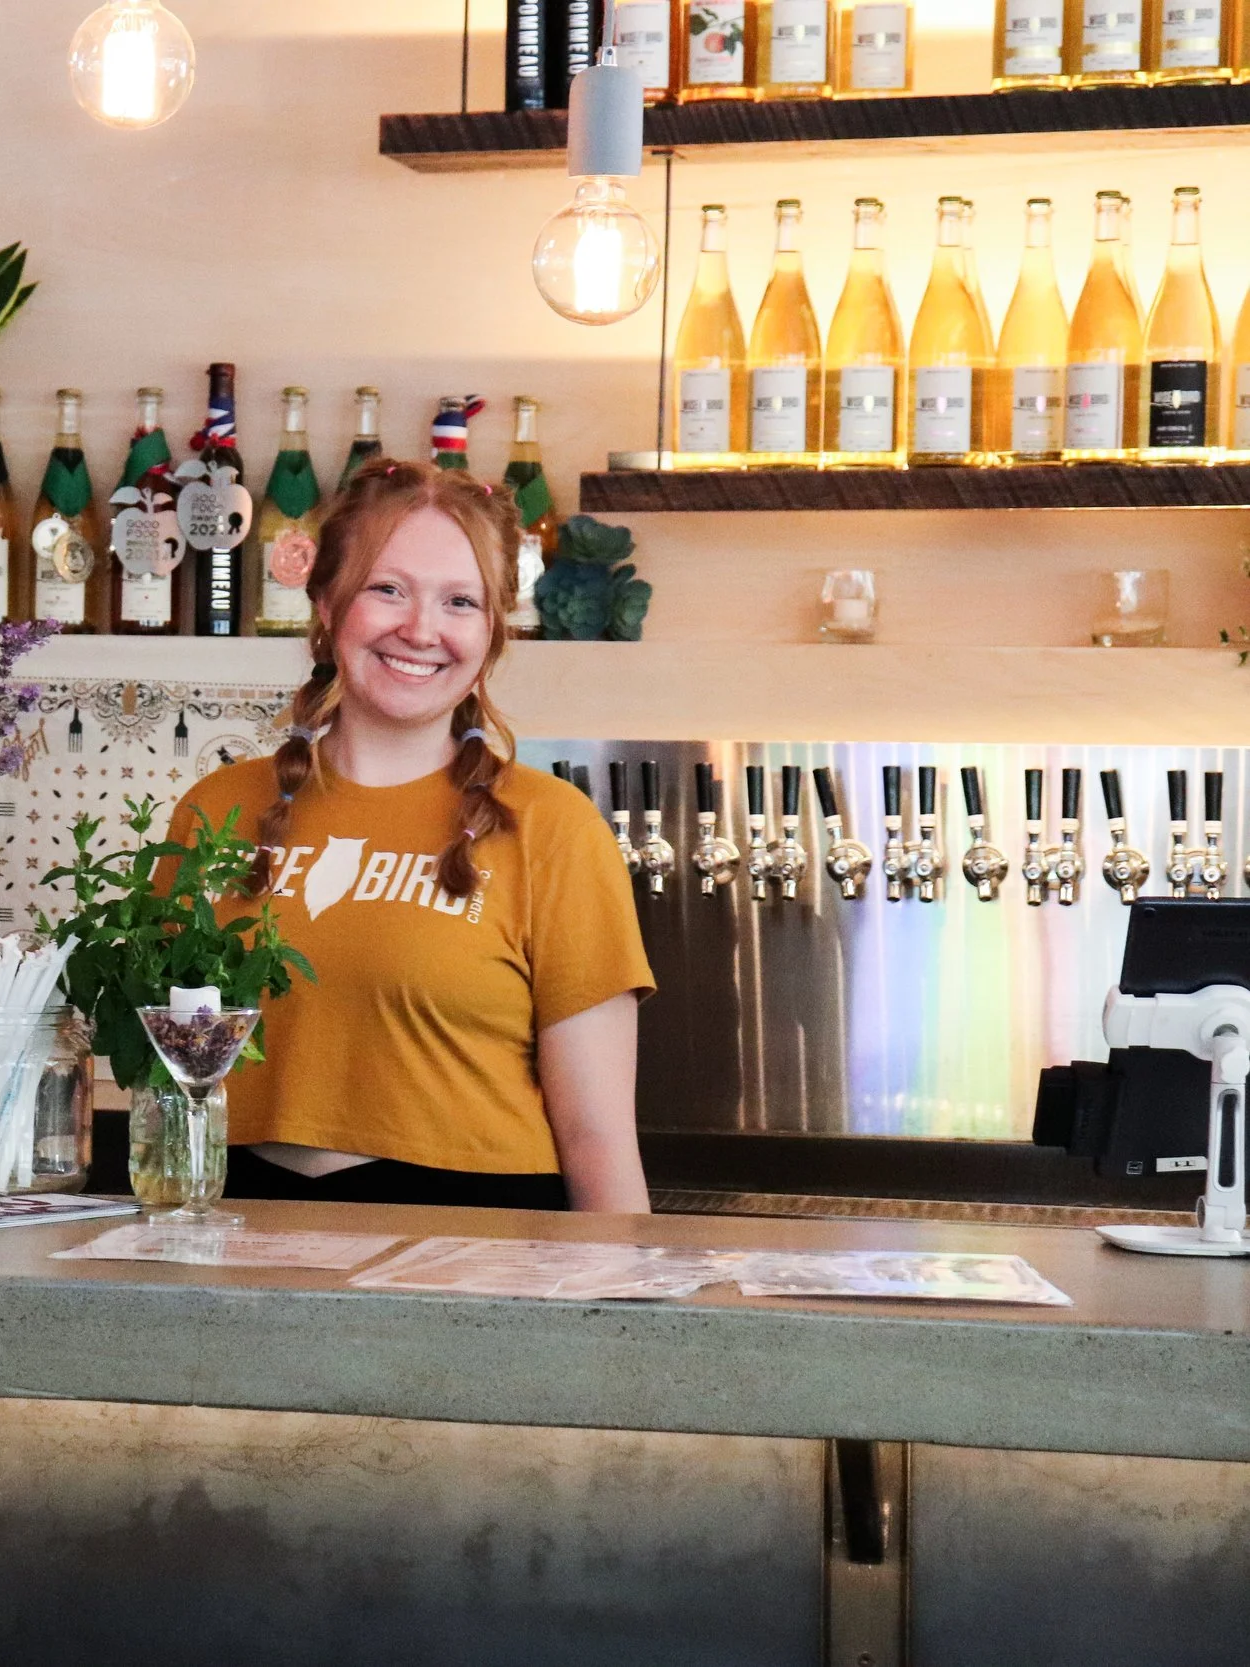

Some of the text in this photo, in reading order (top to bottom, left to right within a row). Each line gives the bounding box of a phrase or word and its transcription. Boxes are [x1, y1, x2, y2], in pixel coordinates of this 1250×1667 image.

[517, 0, 539, 77] OMMEAU
[568, 0, 589, 75] OMMEAU
[190, 523, 225, 536] 202
